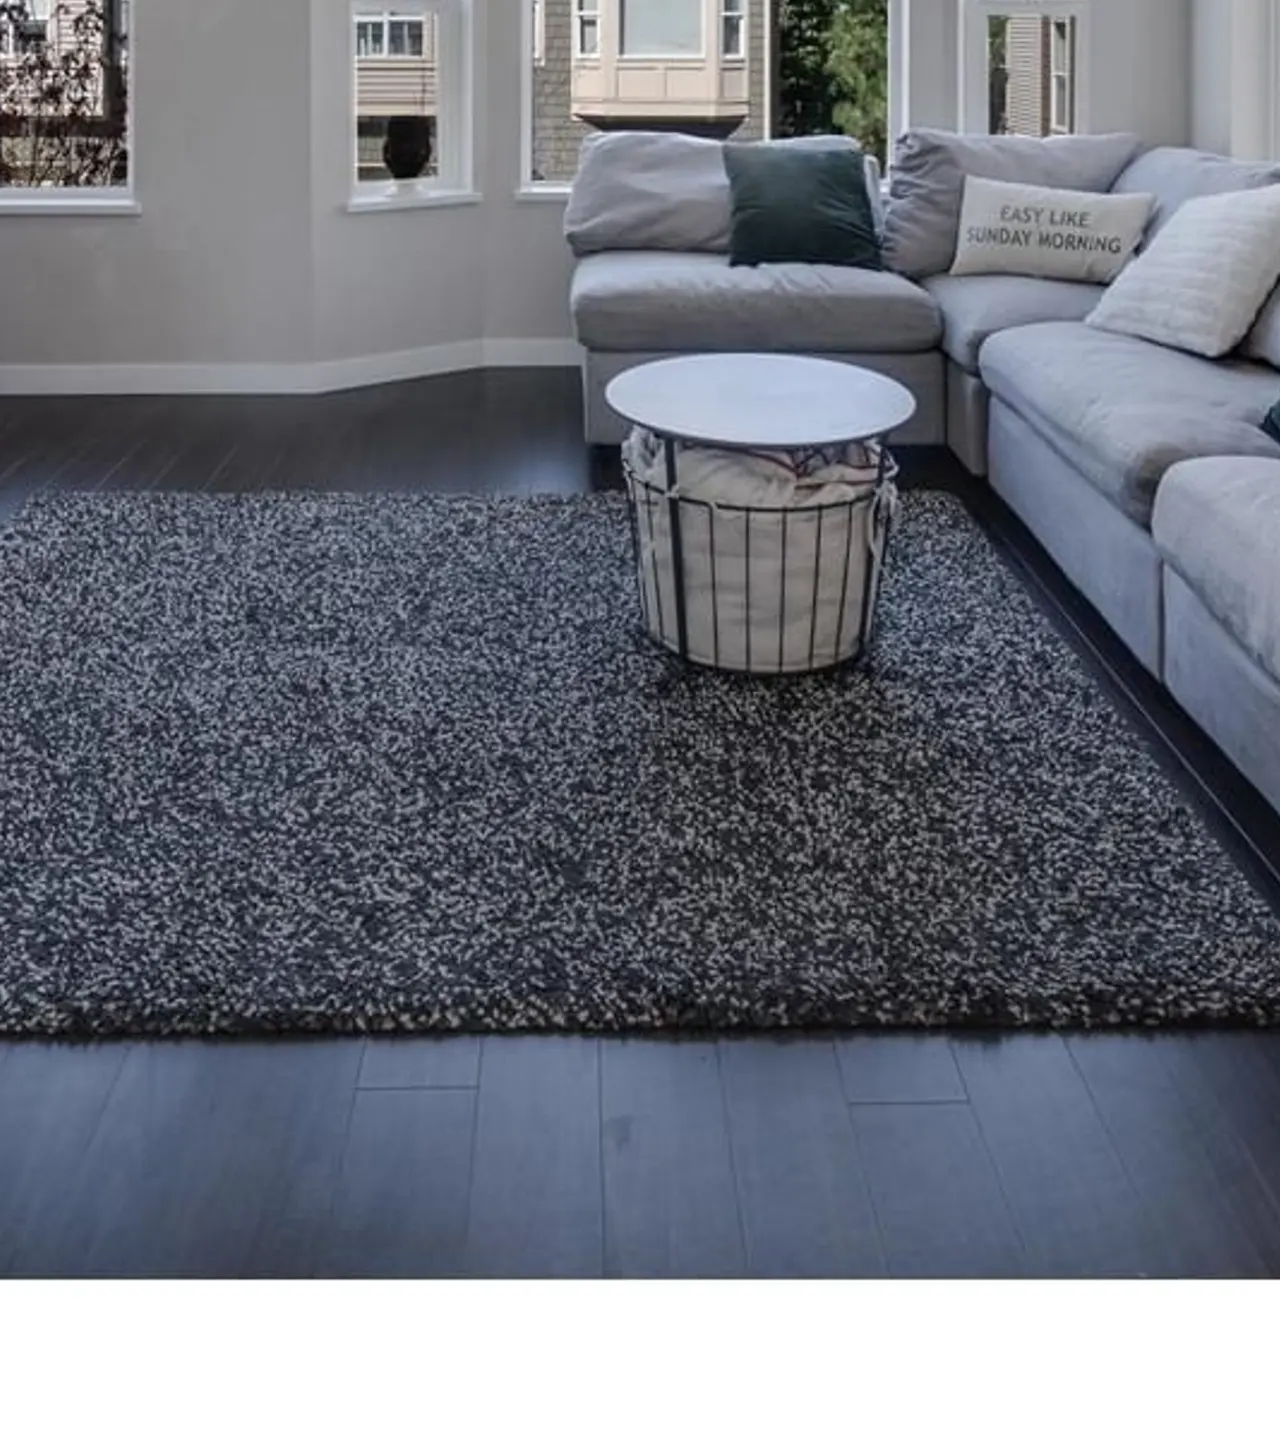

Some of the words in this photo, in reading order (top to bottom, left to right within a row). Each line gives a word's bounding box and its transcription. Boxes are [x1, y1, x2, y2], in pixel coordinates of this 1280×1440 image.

[1000, 205, 1044, 224] EASY
[1050, 210, 1091, 226] LIKE
[967, 226, 1033, 246] SUNDAY
[1038, 231, 1121, 253] MORNING
